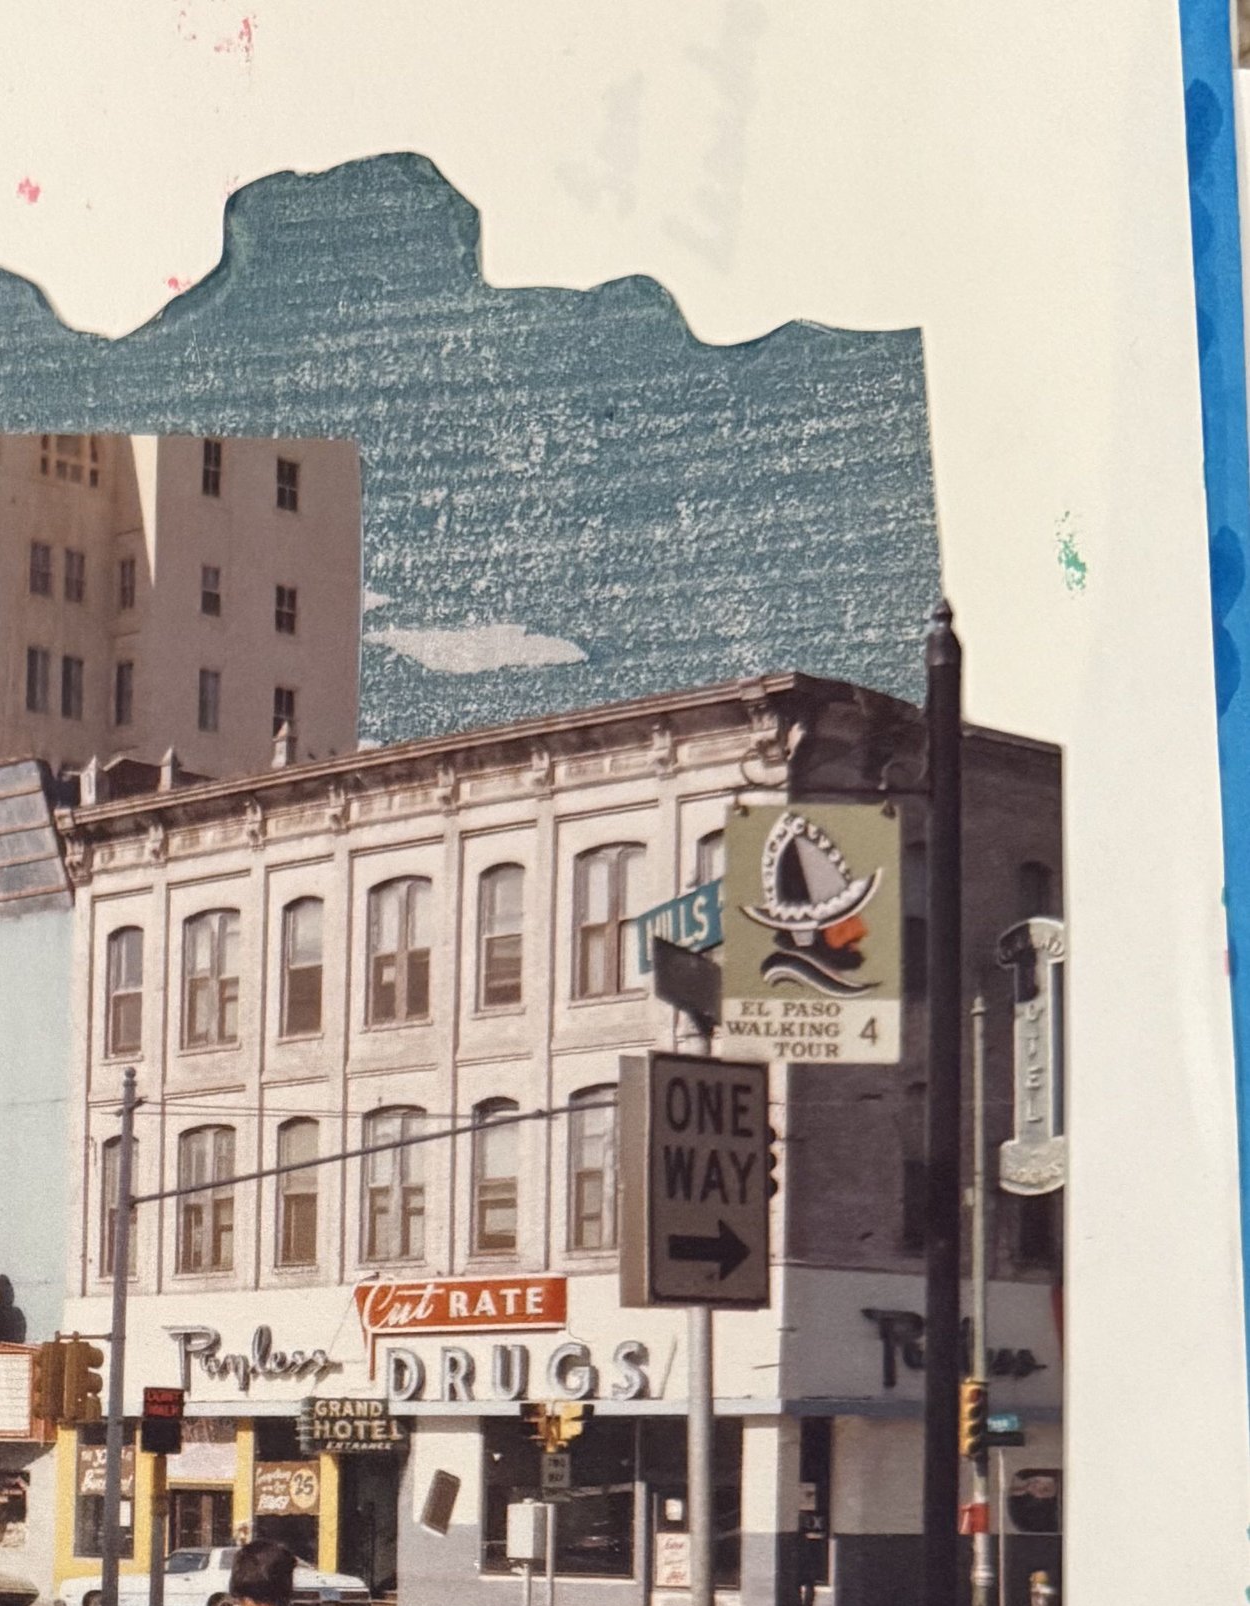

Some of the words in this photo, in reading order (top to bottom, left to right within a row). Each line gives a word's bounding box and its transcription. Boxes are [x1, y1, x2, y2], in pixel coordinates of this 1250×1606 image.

[739, 1001, 768, 1018] EL
[782, 1001, 842, 1018] PASO
[726, 1021, 841, 1038] WALKING
[859, 1017, 879, 1045] 4
[775, 1042, 840, 1059] TOUR
[665, 1076, 754, 1139] ONE
[662, 1144, 757, 1206] WAY
[363, 1280, 445, 1330] Cut
[449, 1287, 544, 1317] RATE
[162, 1324, 342, 1394] Payless
[385, 1340, 650, 1401] DRUGS
[314, 1400, 384, 1417] GRAND
[313, 1419, 403, 1441] HOTEL
[325, 1441, 394, 1450] ENTRANCE
[294, 1473, 315, 1496] 25
